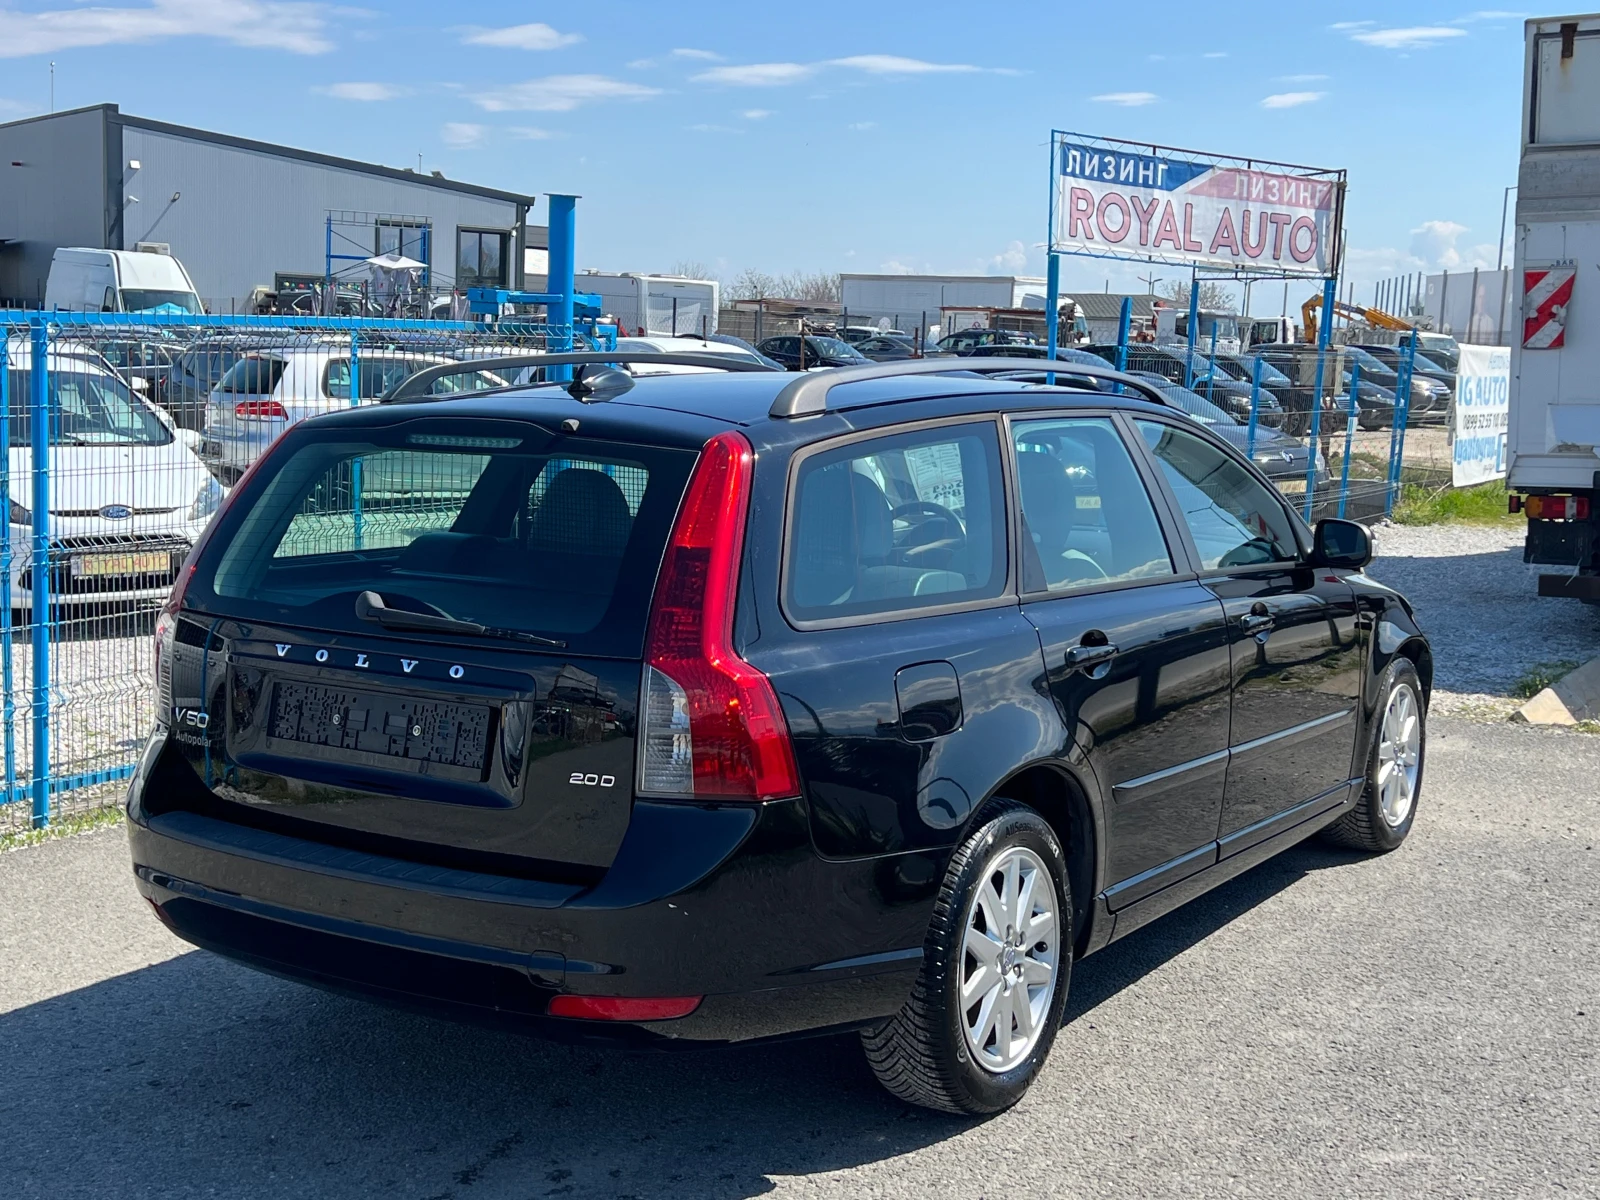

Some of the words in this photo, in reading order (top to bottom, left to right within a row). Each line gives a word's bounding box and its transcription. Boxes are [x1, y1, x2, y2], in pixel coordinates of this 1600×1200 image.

[1066, 149, 1169, 187] ЛИЗИНГ
[1233, 173, 1327, 207] ЛИЗИНГ
[1069, 187, 1202, 252] ROYAL
[1209, 207, 1318, 263] AUTO
[1458, 375, 1473, 406] IG
[1475, 375, 1507, 406] AUTO
[84, 557, 127, 572] RYAL
[133, 555, 168, 568] AUTO
[275, 644, 465, 678] VOLVO
[175, 706, 209, 728] V50
[175, 729, 213, 748] Autopolar
